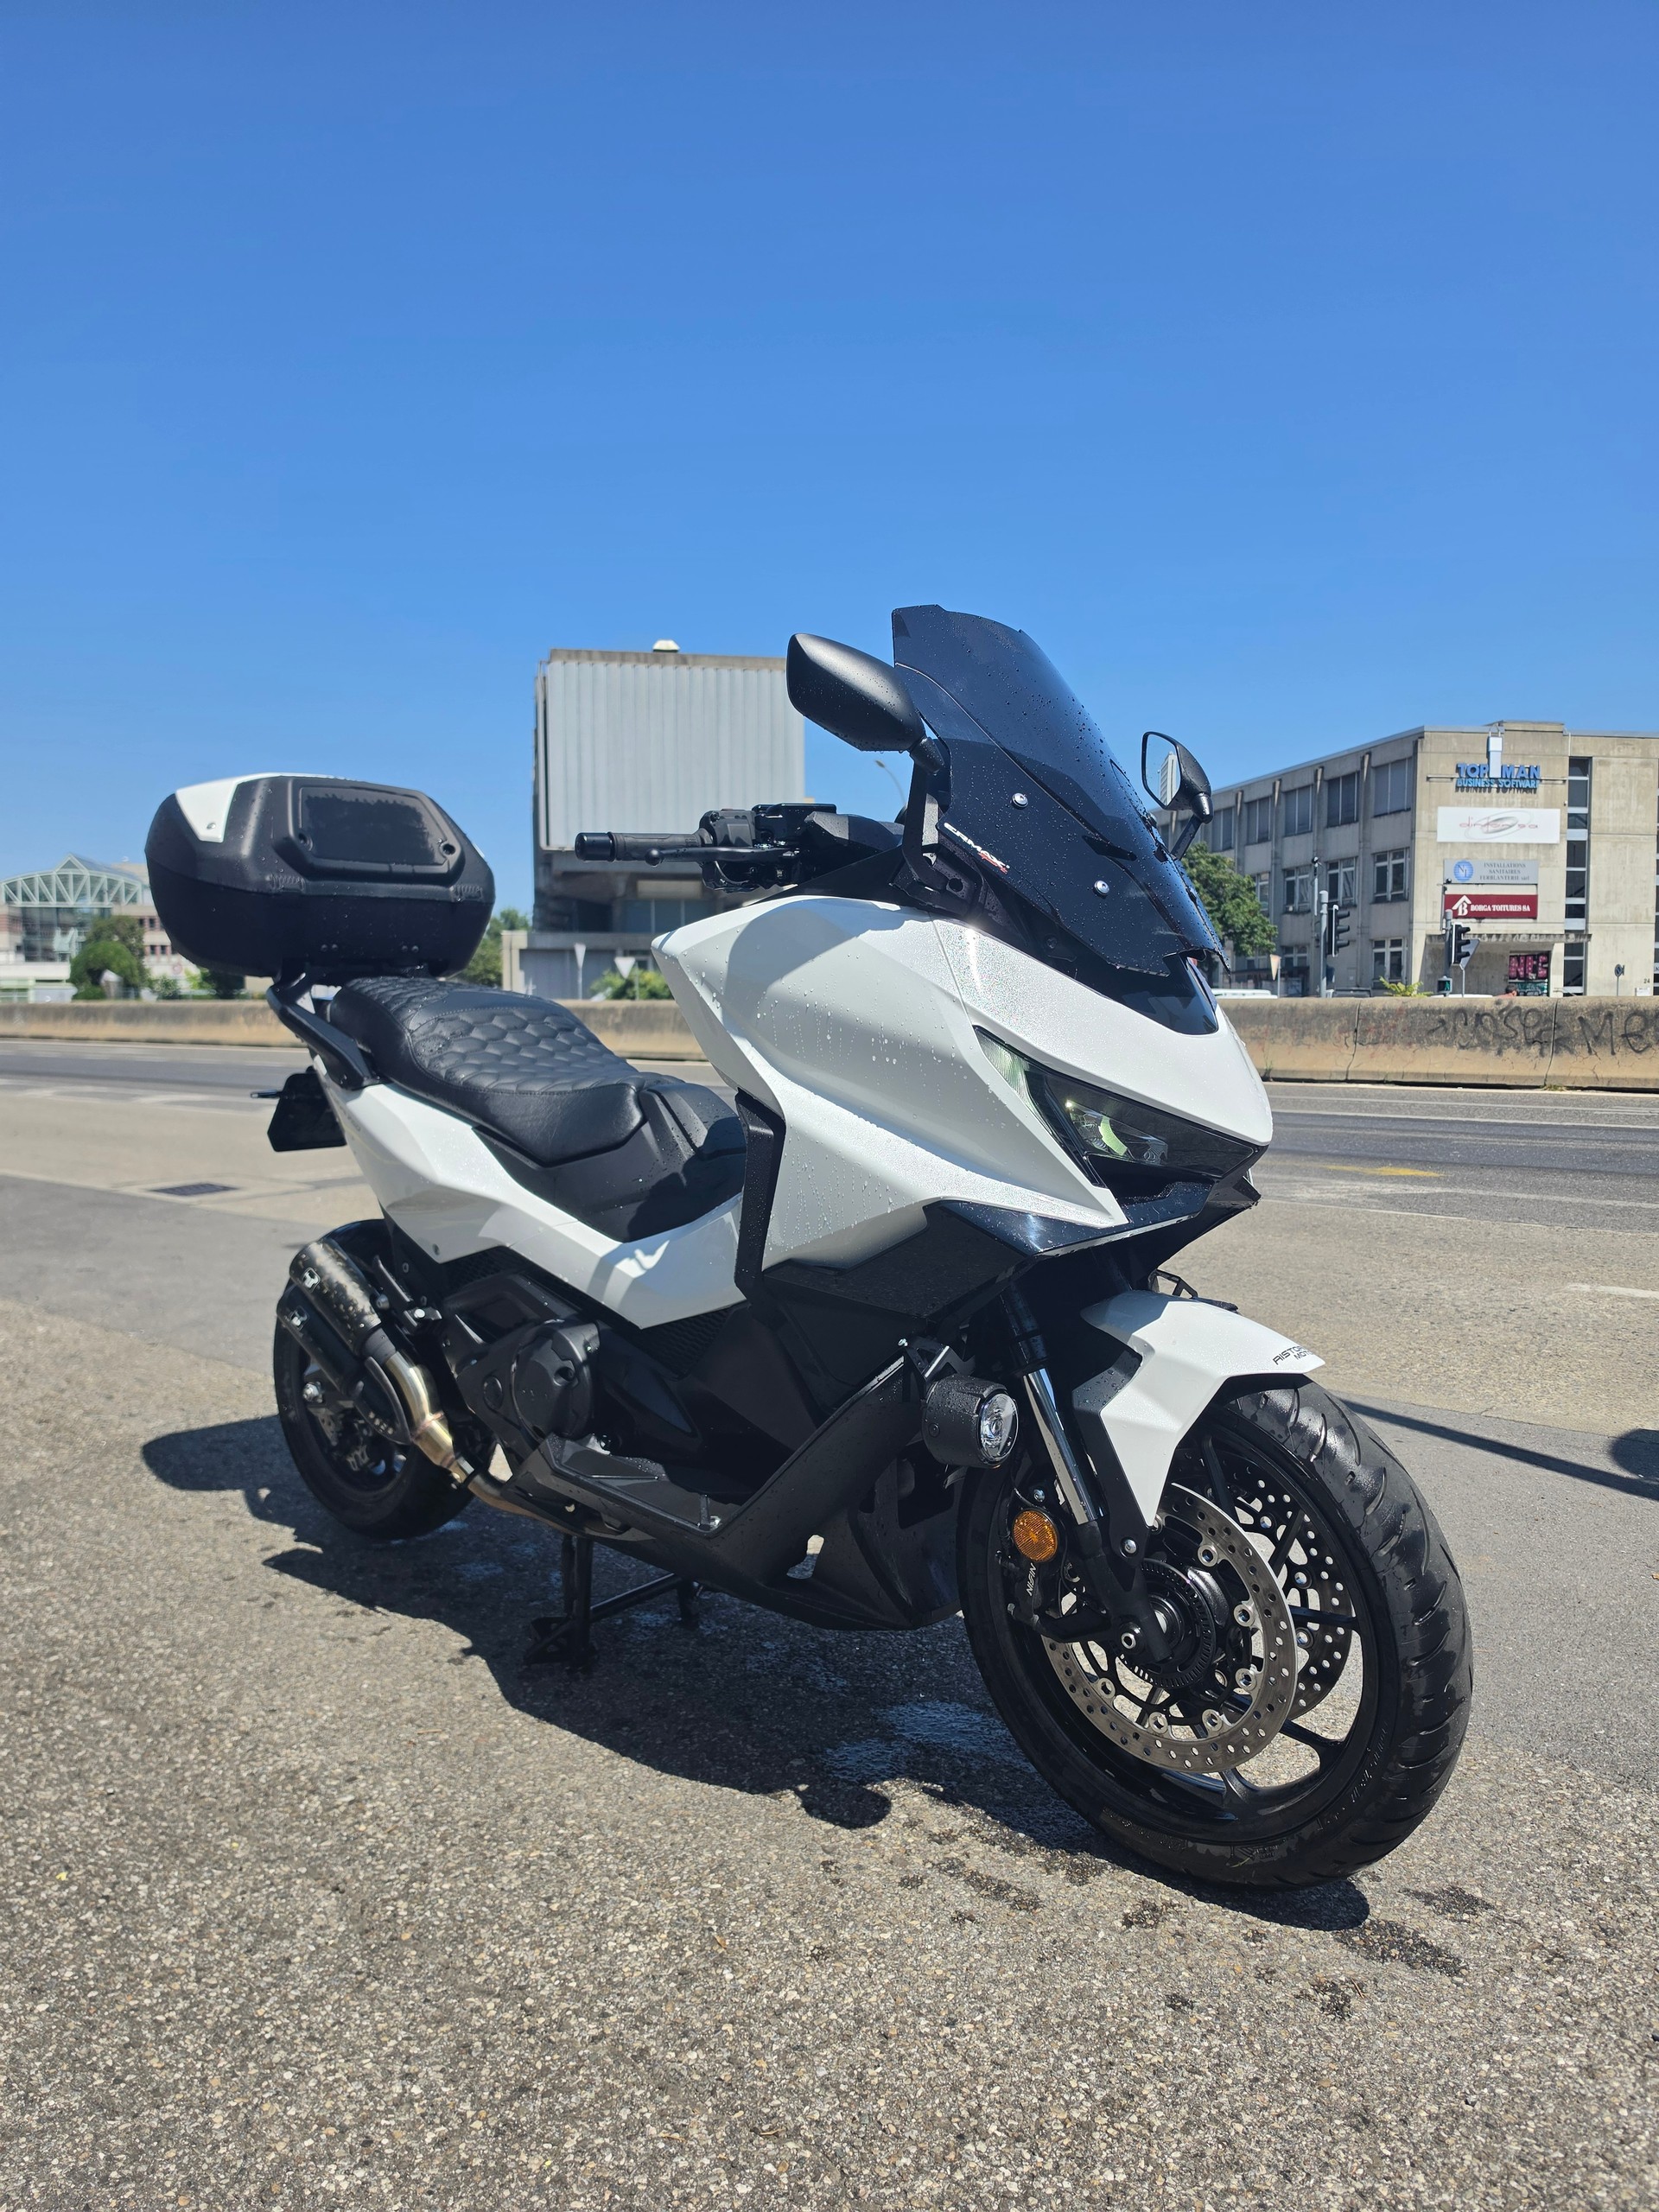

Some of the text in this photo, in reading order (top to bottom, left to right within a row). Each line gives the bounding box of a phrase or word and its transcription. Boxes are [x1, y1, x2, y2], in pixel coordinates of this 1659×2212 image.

[1457, 763, 1540, 779] TOP MAN
[1457, 778, 1496, 787] BUSINESS
